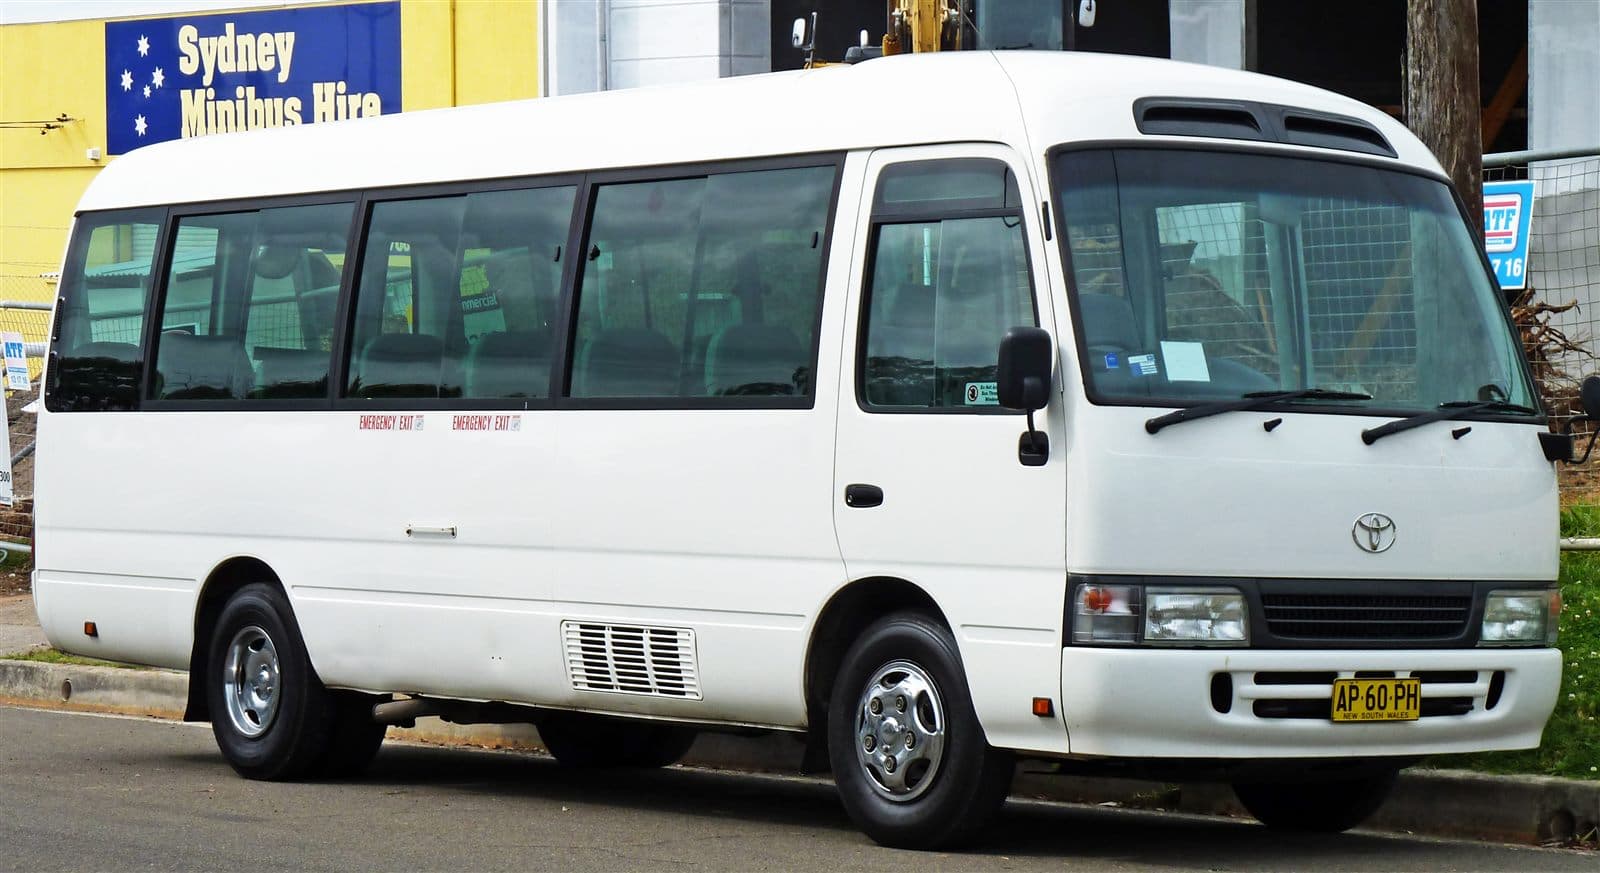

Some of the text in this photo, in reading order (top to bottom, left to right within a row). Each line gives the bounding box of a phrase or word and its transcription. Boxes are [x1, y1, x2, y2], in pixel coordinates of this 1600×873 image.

[179, 22, 295, 86] Sydney
[180, 81, 382, 140] Minibus Hire
[1505, 258, 1522, 277] 16
[5, 341, 23, 359] ATF
[359, 415, 397, 430] EMERGENCY
[399, 415, 414, 431] EXIT
[452, 415, 492, 431] EMERGENCY
[494, 415, 511, 431] EXIT
[1343, 711, 1409, 720] NEW SOUTH WALES
